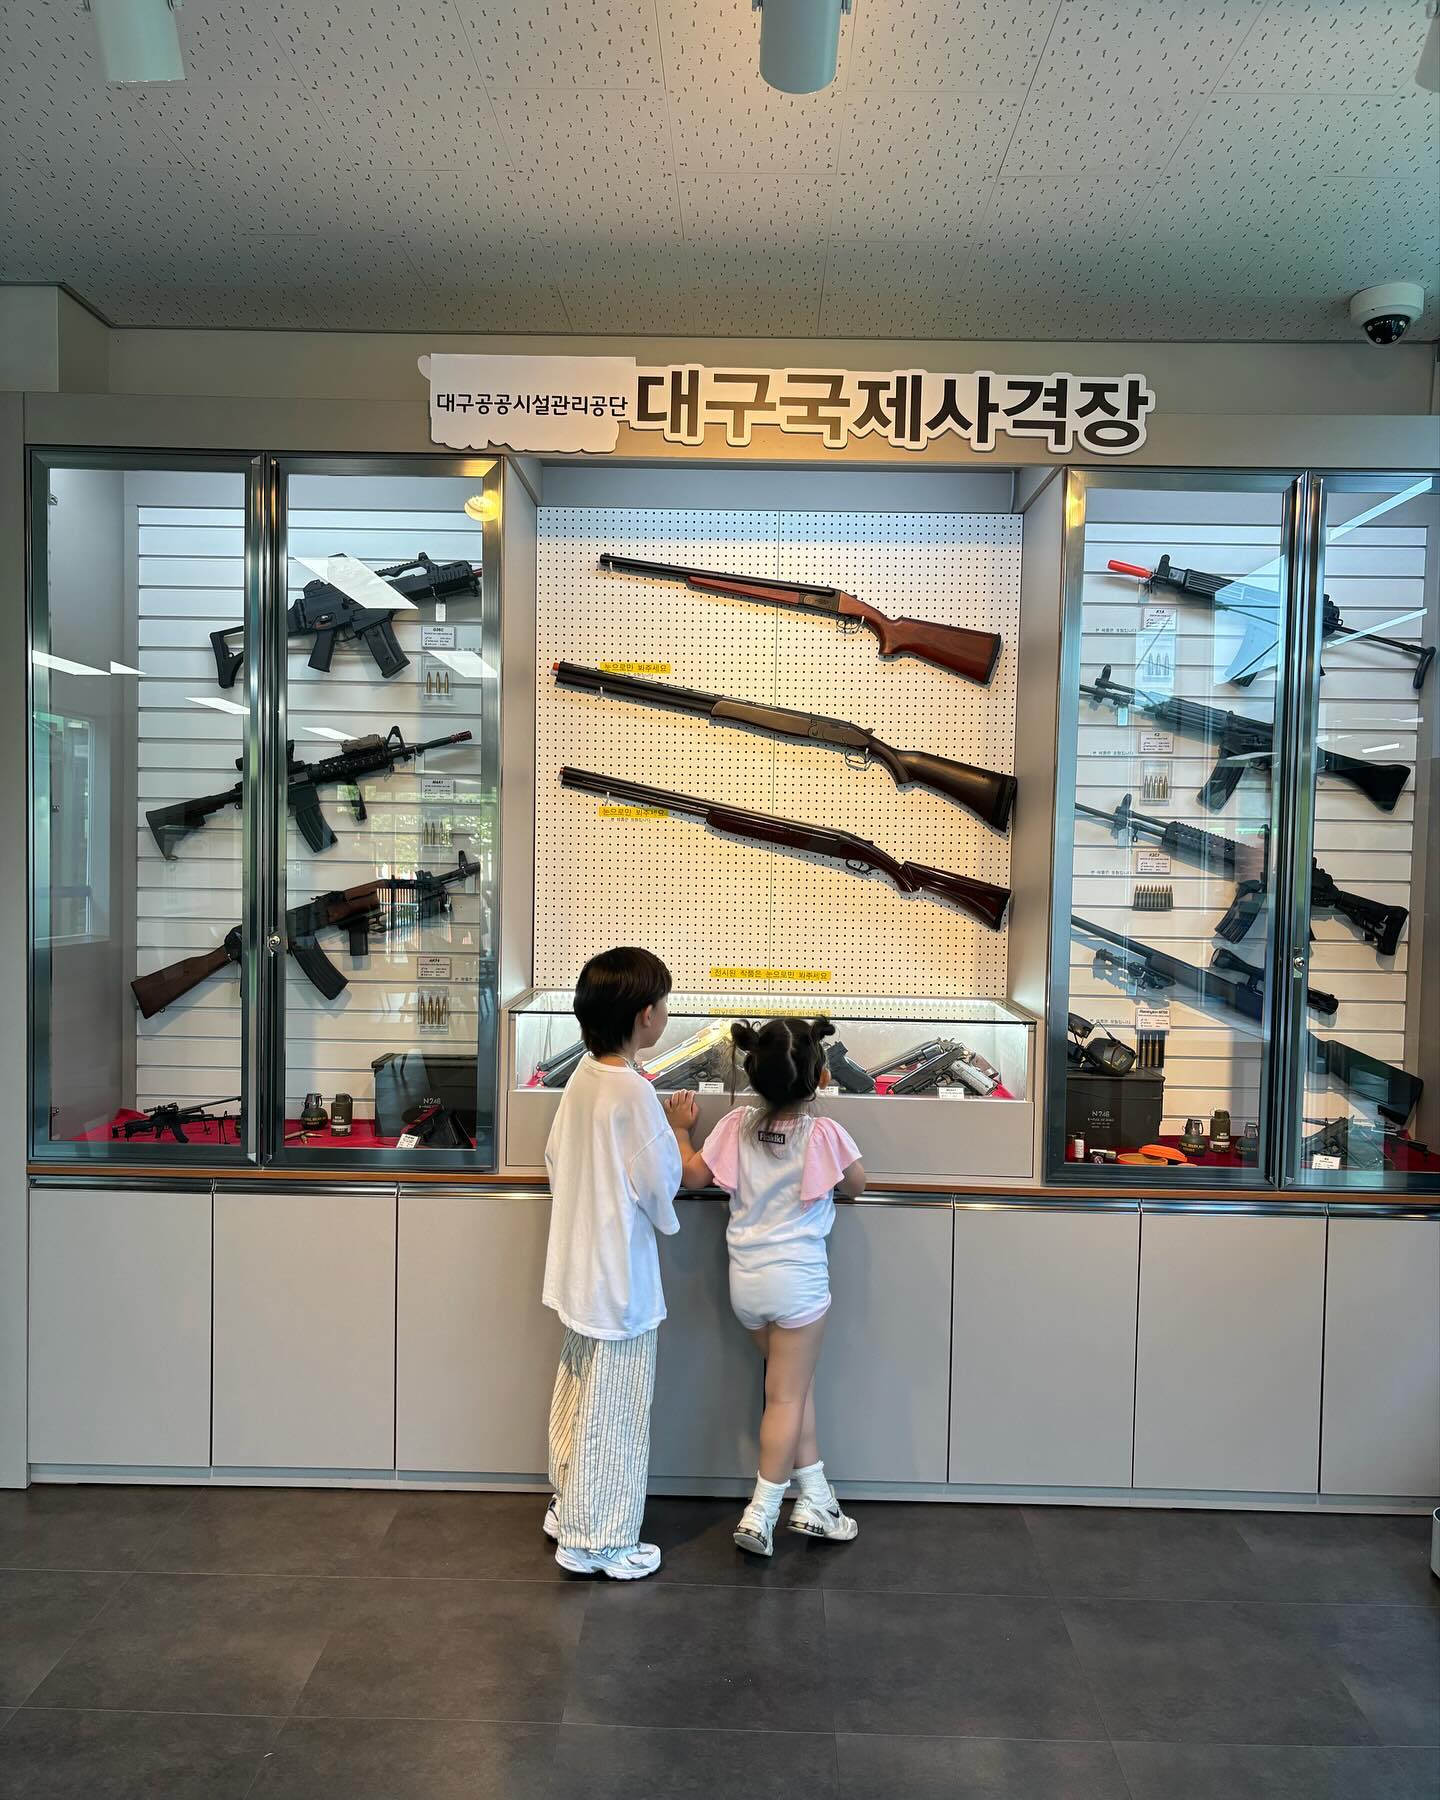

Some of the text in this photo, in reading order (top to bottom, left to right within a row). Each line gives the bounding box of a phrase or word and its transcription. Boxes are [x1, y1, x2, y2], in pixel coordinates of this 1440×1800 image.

[436, 369, 1149, 448] 대구공공시설관리공단 대구국제사격장
[602, 808, 632, 817] 눈으로만
[714, 968, 736, 977] 전시된
[766, 969, 795, 979] 눈으로만
